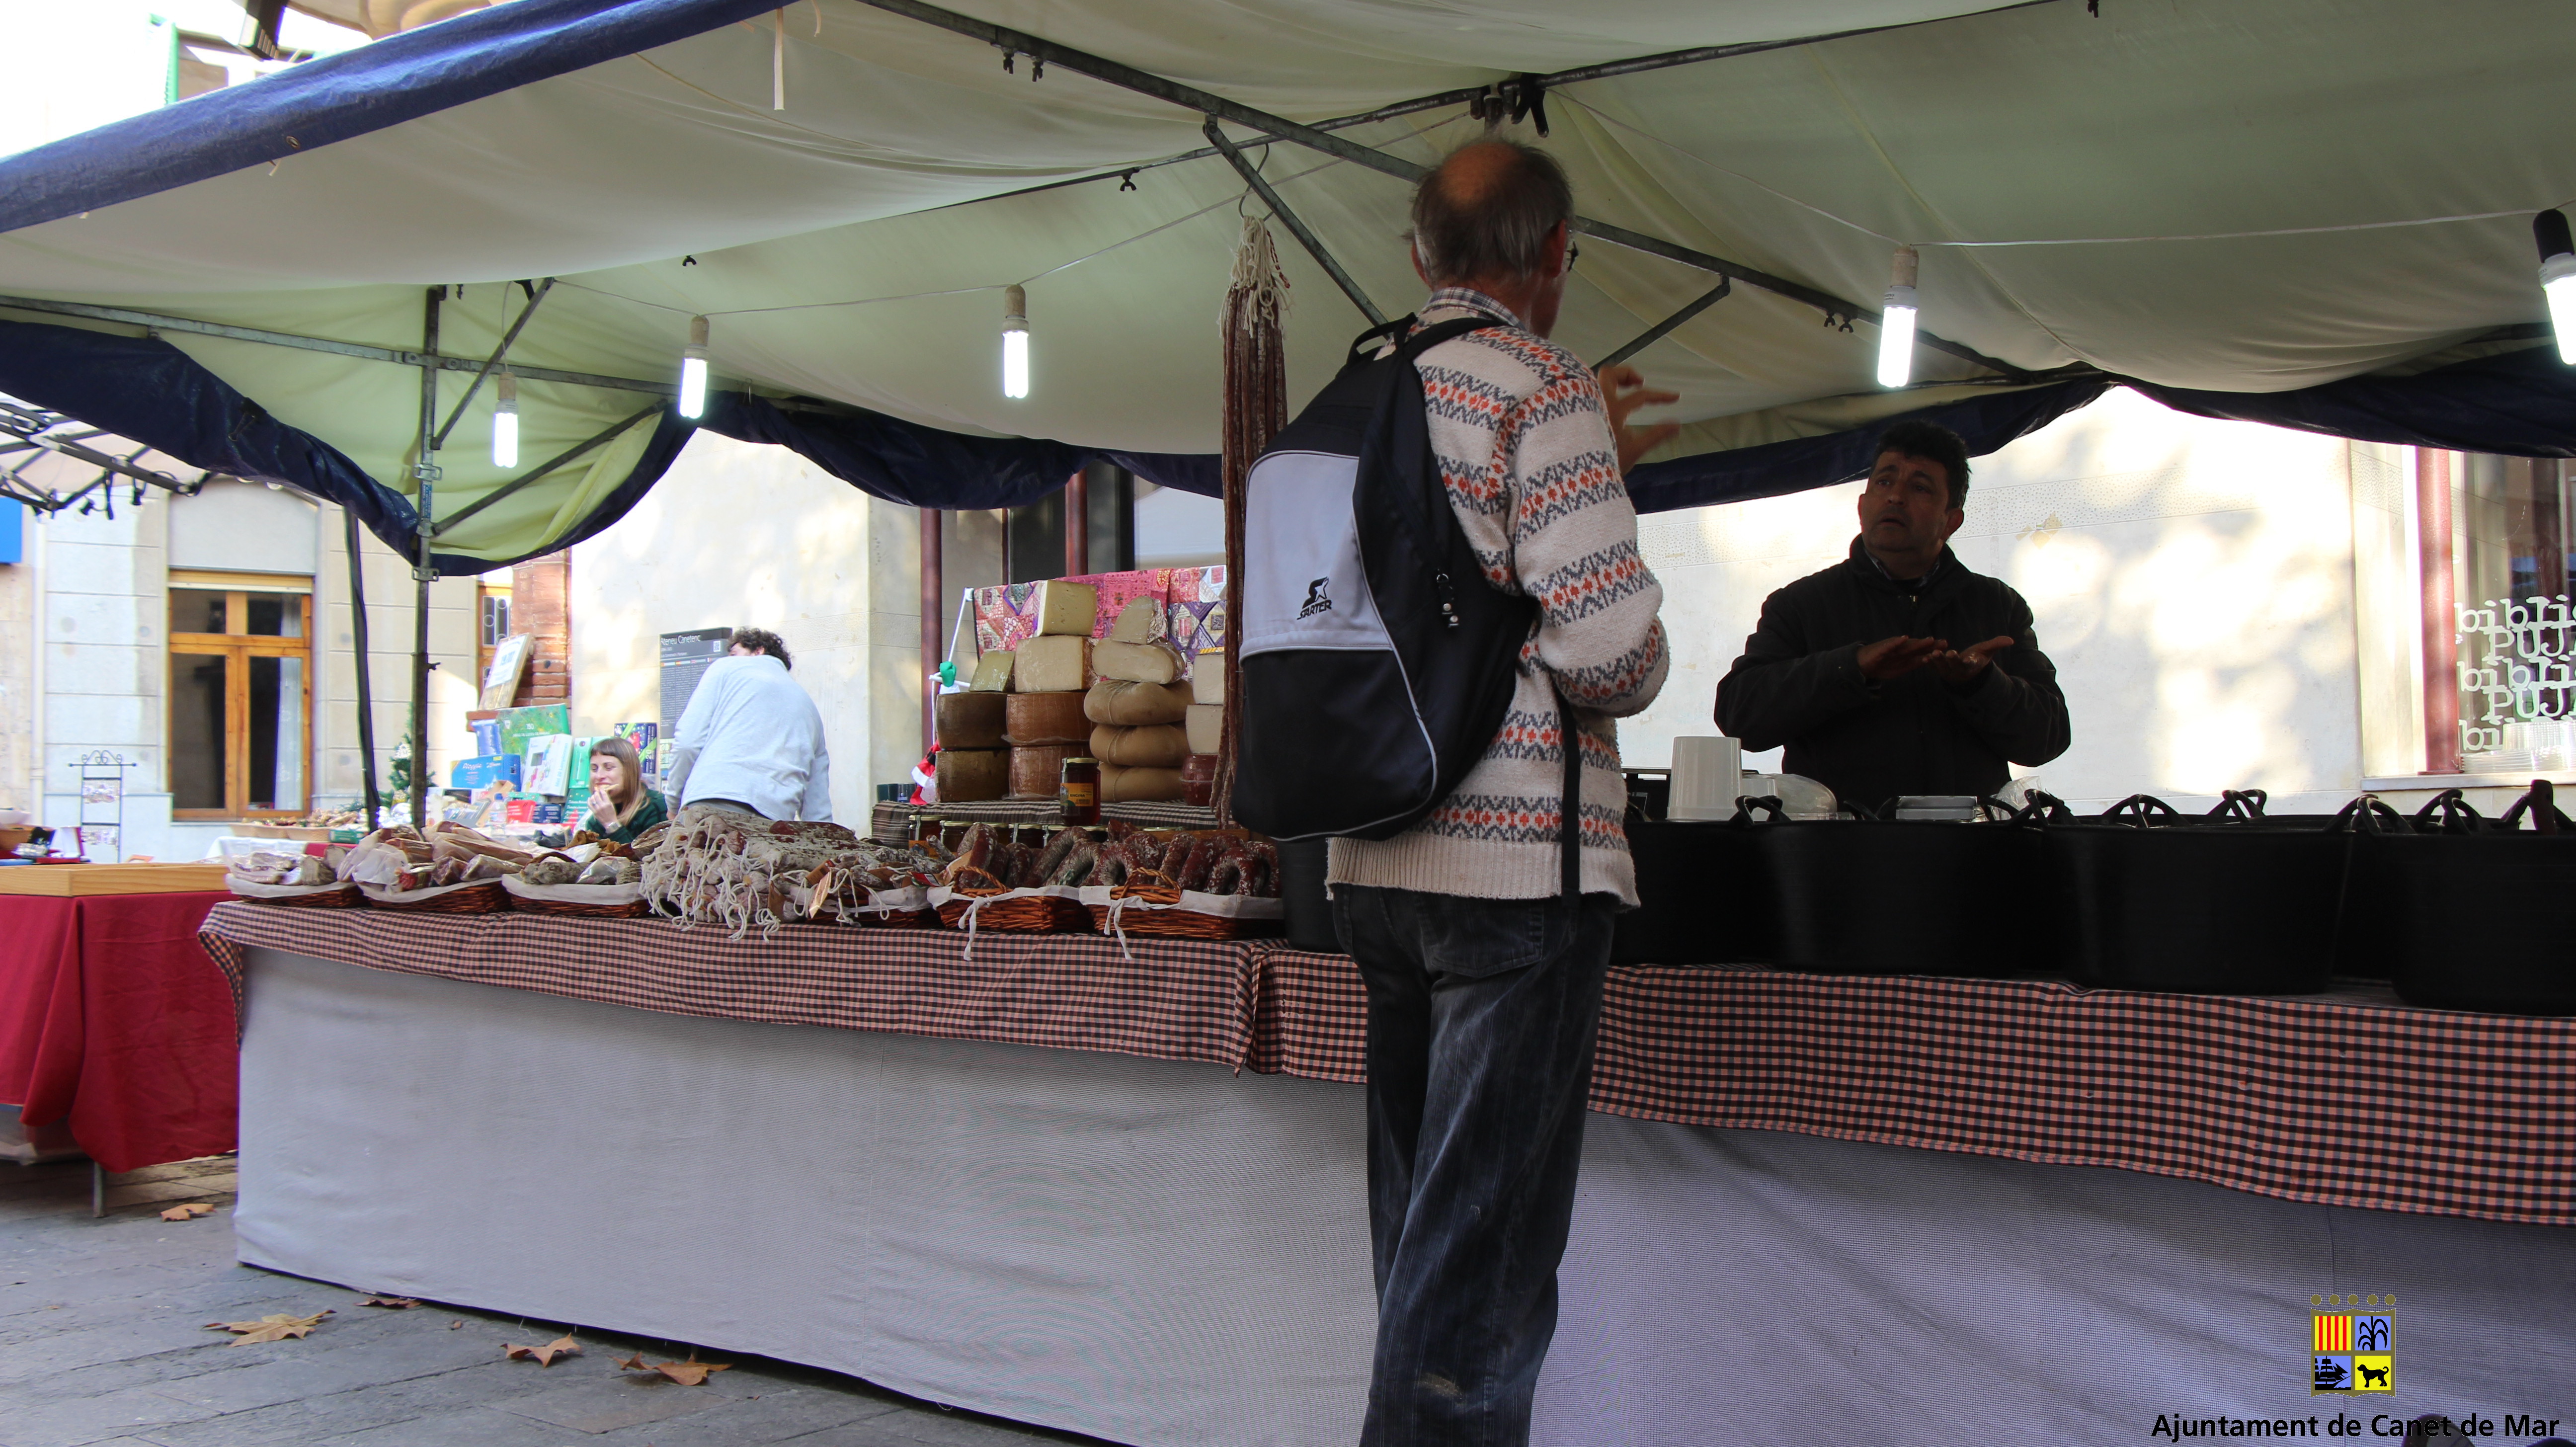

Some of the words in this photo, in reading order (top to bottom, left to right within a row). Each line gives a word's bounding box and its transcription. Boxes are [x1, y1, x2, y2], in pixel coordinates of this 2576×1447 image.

[1296, 599, 1332, 620] STARTER
[2454, 594, 2576, 633] bibli
[2457, 654, 2576, 692] bibli
